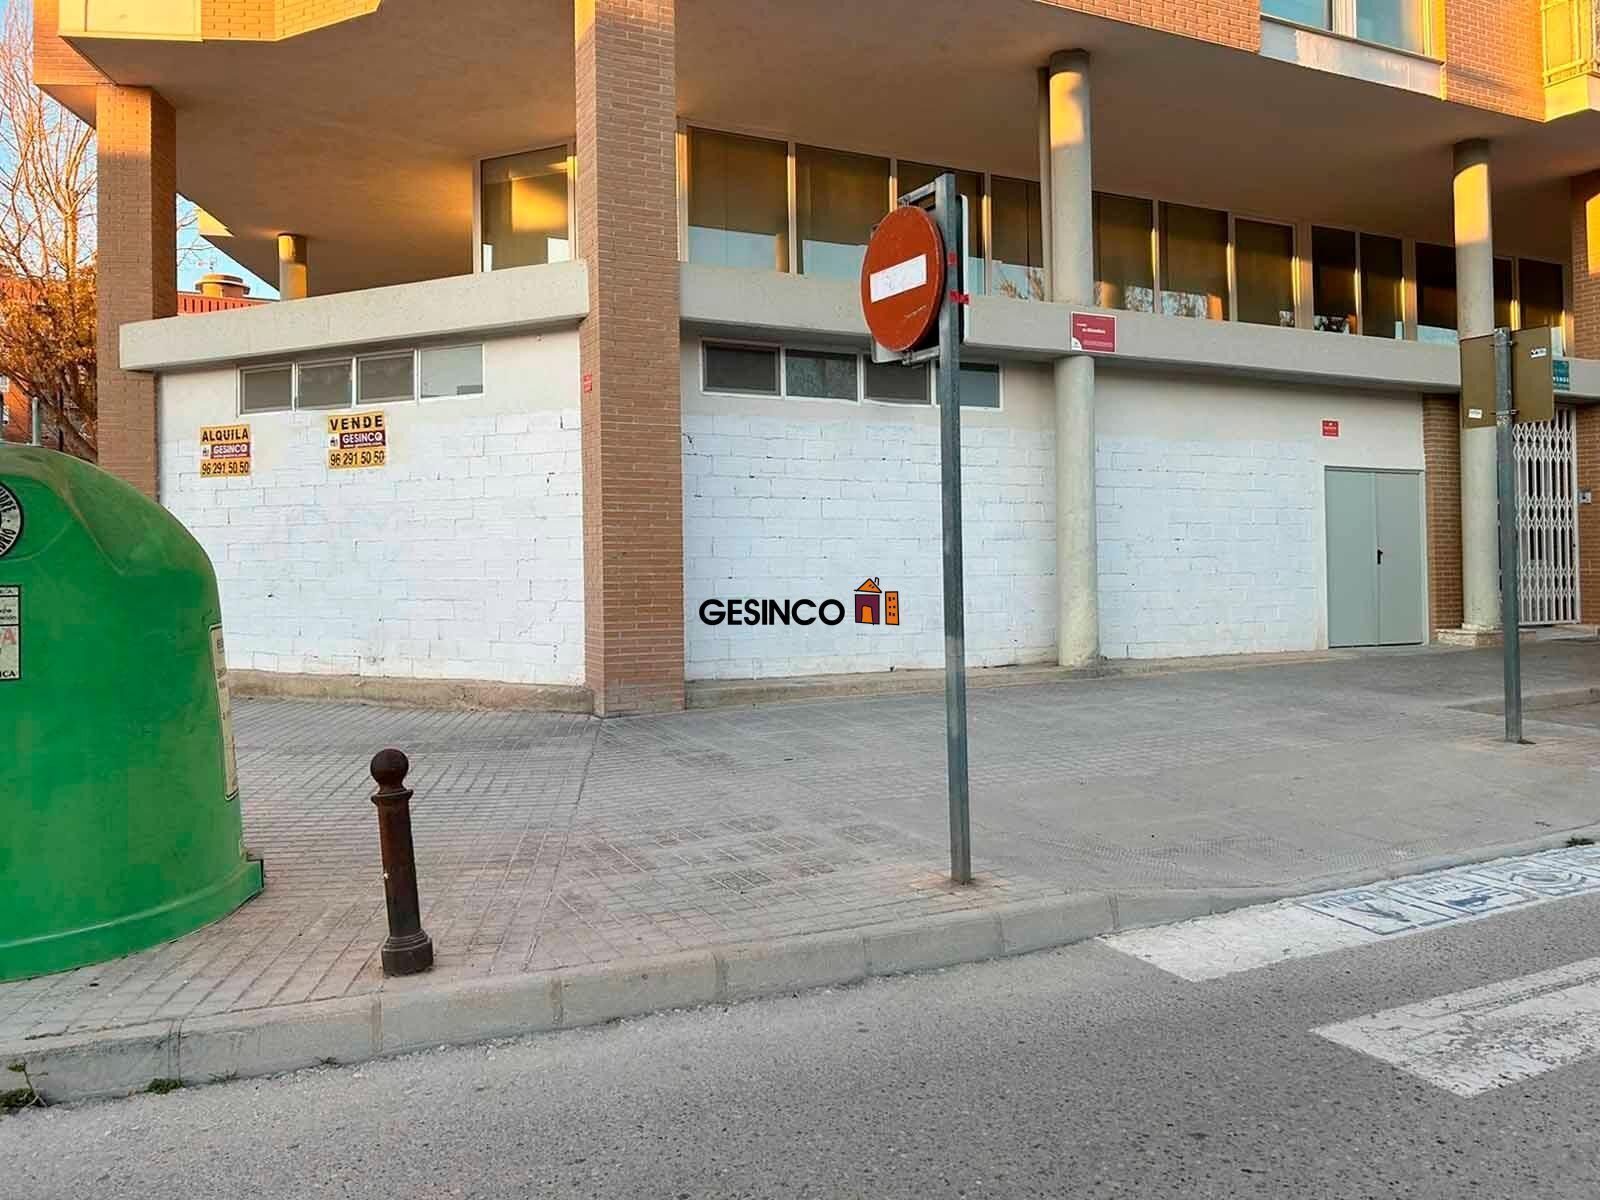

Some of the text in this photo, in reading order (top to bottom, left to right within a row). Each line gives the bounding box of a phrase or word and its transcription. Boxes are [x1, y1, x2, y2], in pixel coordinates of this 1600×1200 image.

[330, 415, 383, 431] VENDE
[202, 428, 248, 442] ALQUILA
[342, 432, 383, 444] GESINCO
[213, 444, 248, 455] GESINCO
[330, 450, 385, 467] 96 291 50 50
[202, 461, 249, 475] 96 291 50 50
